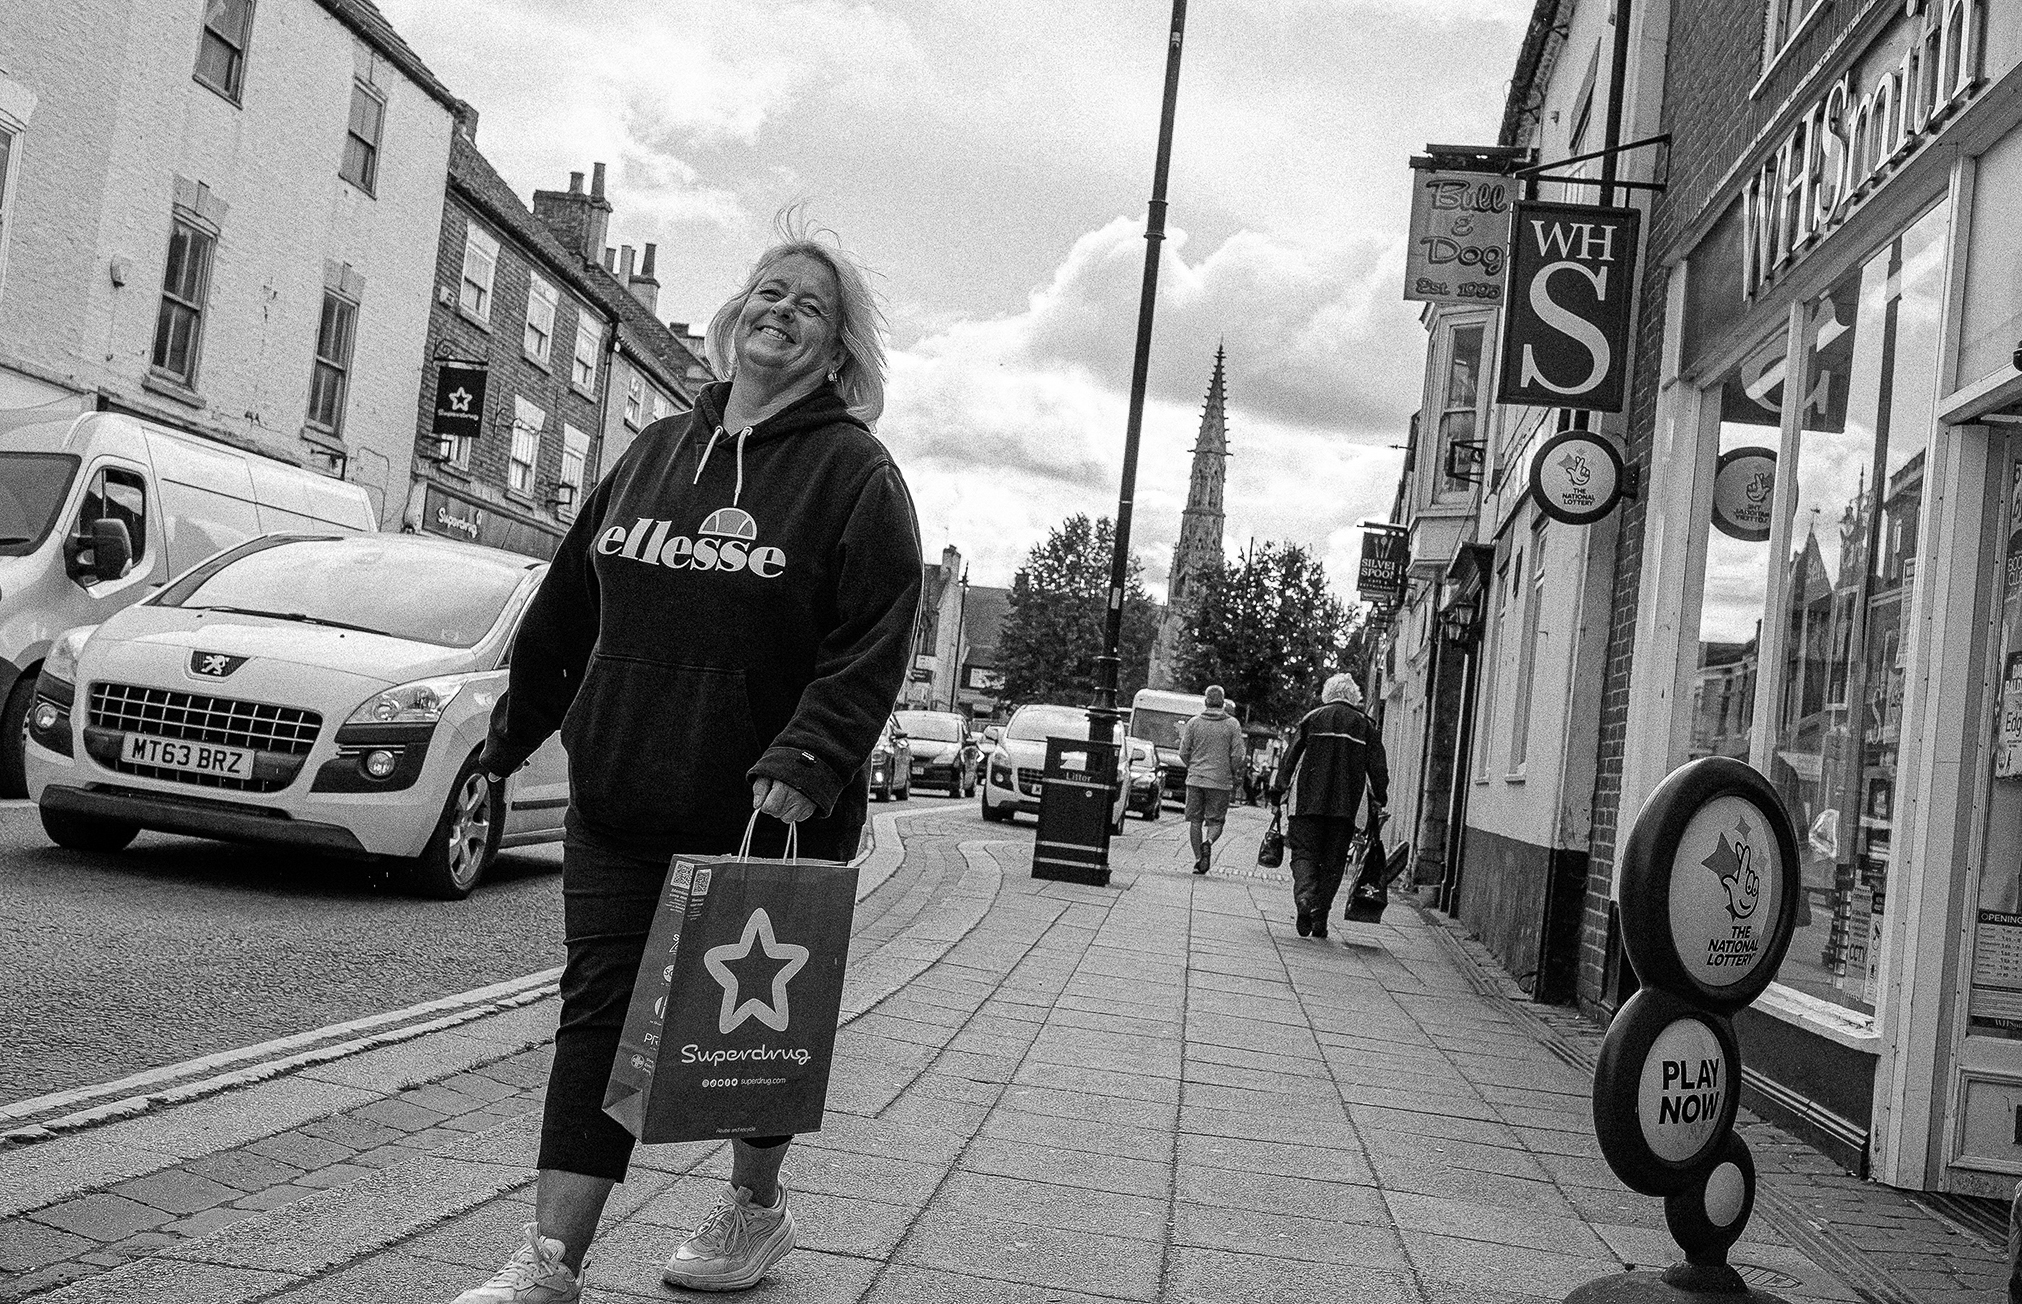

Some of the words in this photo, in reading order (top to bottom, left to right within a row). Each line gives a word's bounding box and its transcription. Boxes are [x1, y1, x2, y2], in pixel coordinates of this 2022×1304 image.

[1742, 0, 1977, 302] WHSmith
[1426, 179, 1507, 214] Bull
[1420, 235, 1505, 276] Dog
[1530, 220, 1617, 261] WH
[1520, 261, 1611, 395] S
[1562, 492, 1595, 502] NATIONAL
[596, 517, 787, 579] ellesse
[131, 737, 192, 767] MT63
[196, 747, 243, 774] BRZ
[1707, 938, 1760, 954] NATIONAL
[1731, 925, 1752, 939] THE
[1706, 953, 1756, 967] LOTTERY
[681, 1043, 812, 1067] Superdrug
[740, 1077, 787, 1087] superdrug.com
[1662, 1057, 1720, 1091] PLAY
[1658, 1091, 1720, 1125] NOW
